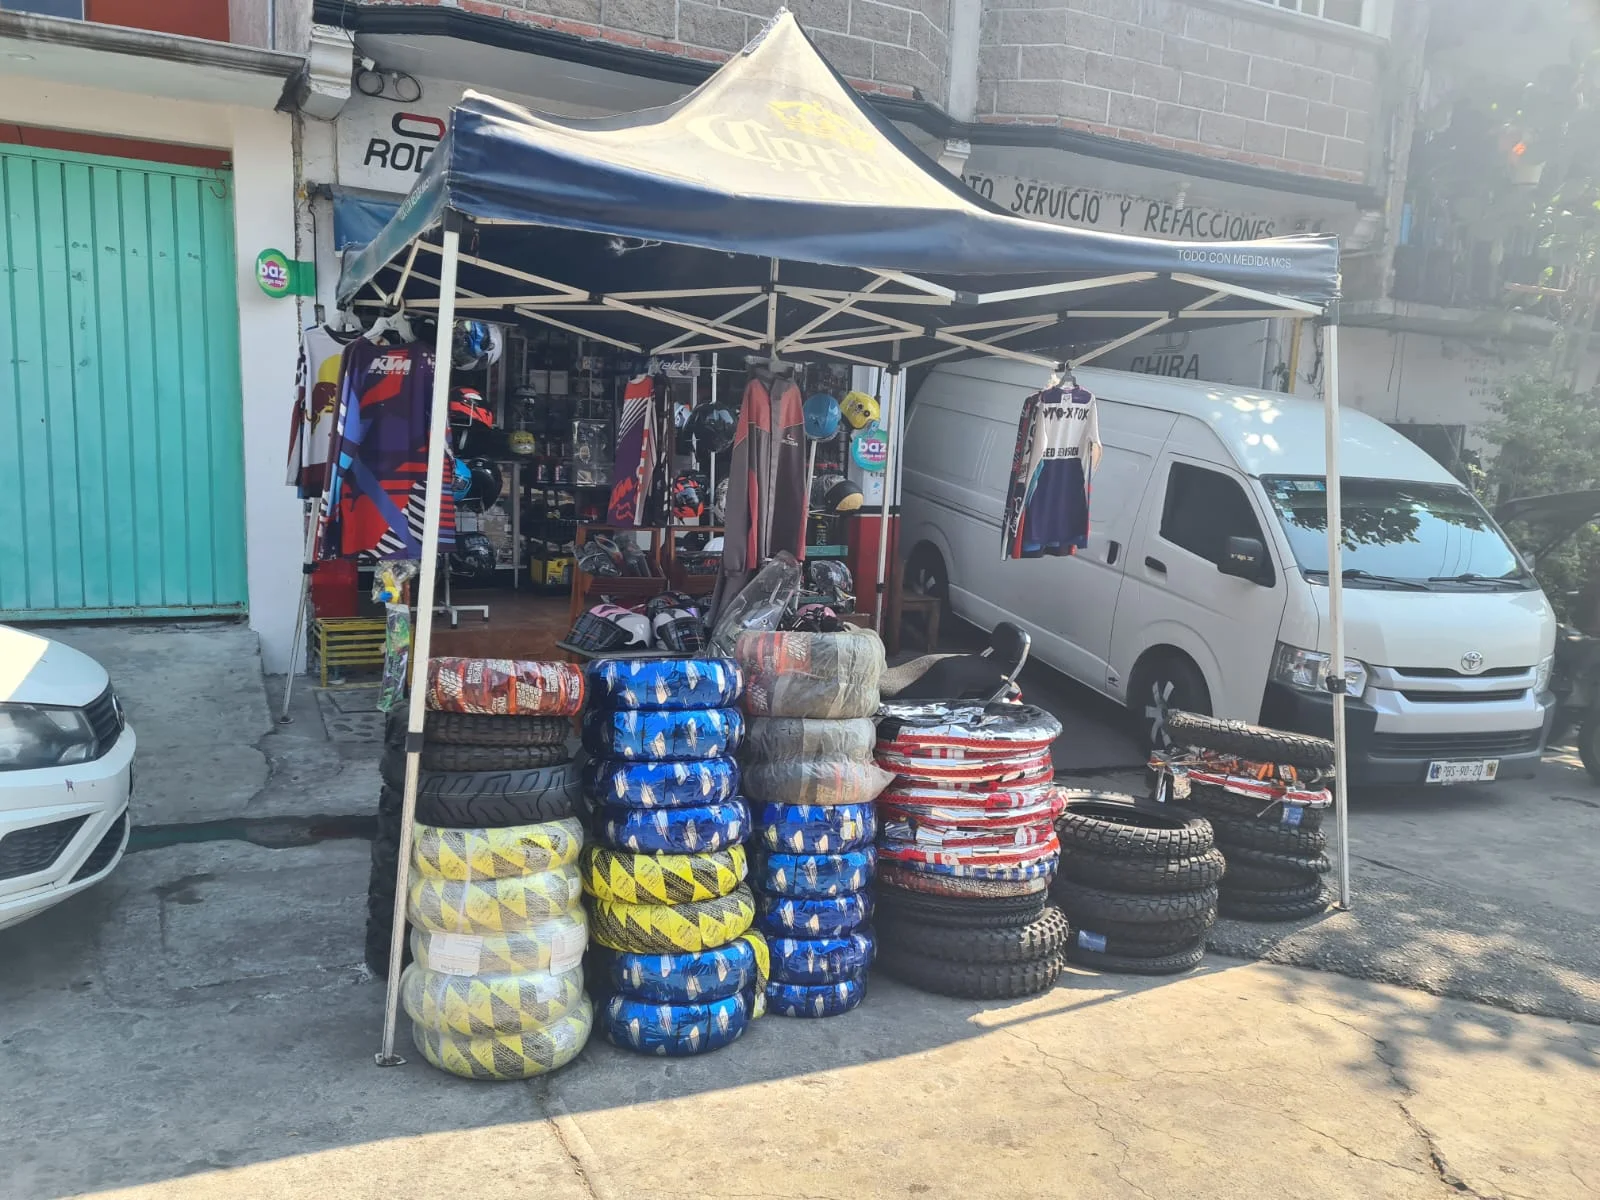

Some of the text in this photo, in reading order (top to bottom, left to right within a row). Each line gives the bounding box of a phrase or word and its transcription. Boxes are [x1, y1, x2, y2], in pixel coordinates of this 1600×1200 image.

[1120, 200, 1131, 228] Y
[1144, 202, 1276, 241] REFACCIONES
[259, 259, 287, 278] baz
[1177, 249, 1207, 263] TODO
[1209, 252, 1232, 265] CON
[1233, 254, 1271, 269] MEDIDA
[370, 355, 412, 370] KTM
